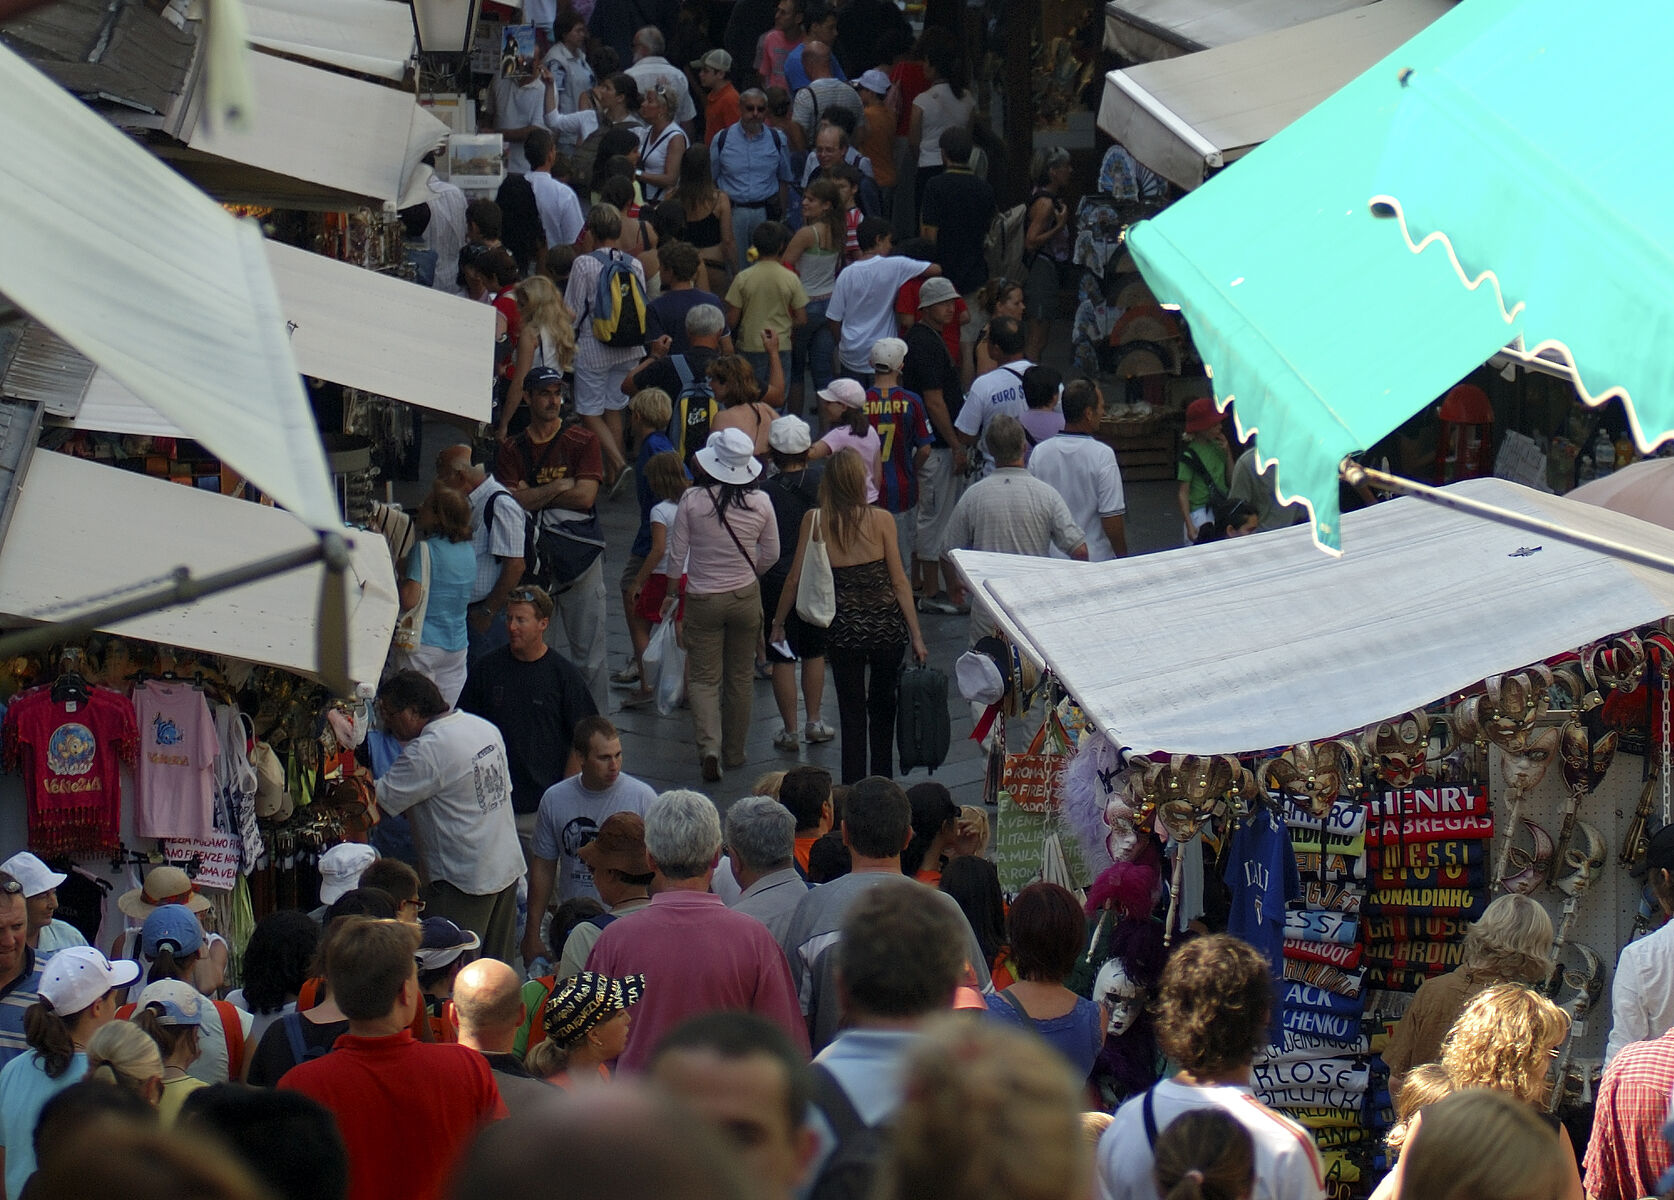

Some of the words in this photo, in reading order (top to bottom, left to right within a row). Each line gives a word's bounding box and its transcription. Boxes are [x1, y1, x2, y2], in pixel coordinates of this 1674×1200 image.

[992, 388, 1016, 405] EURO
[862, 401, 910, 416] SMART
[877, 423, 897, 463] 7
[1371, 786, 1475, 816] HENRY
[1384, 842, 1469, 868] MESSI
[1369, 888, 1474, 909] RONALDINHO
